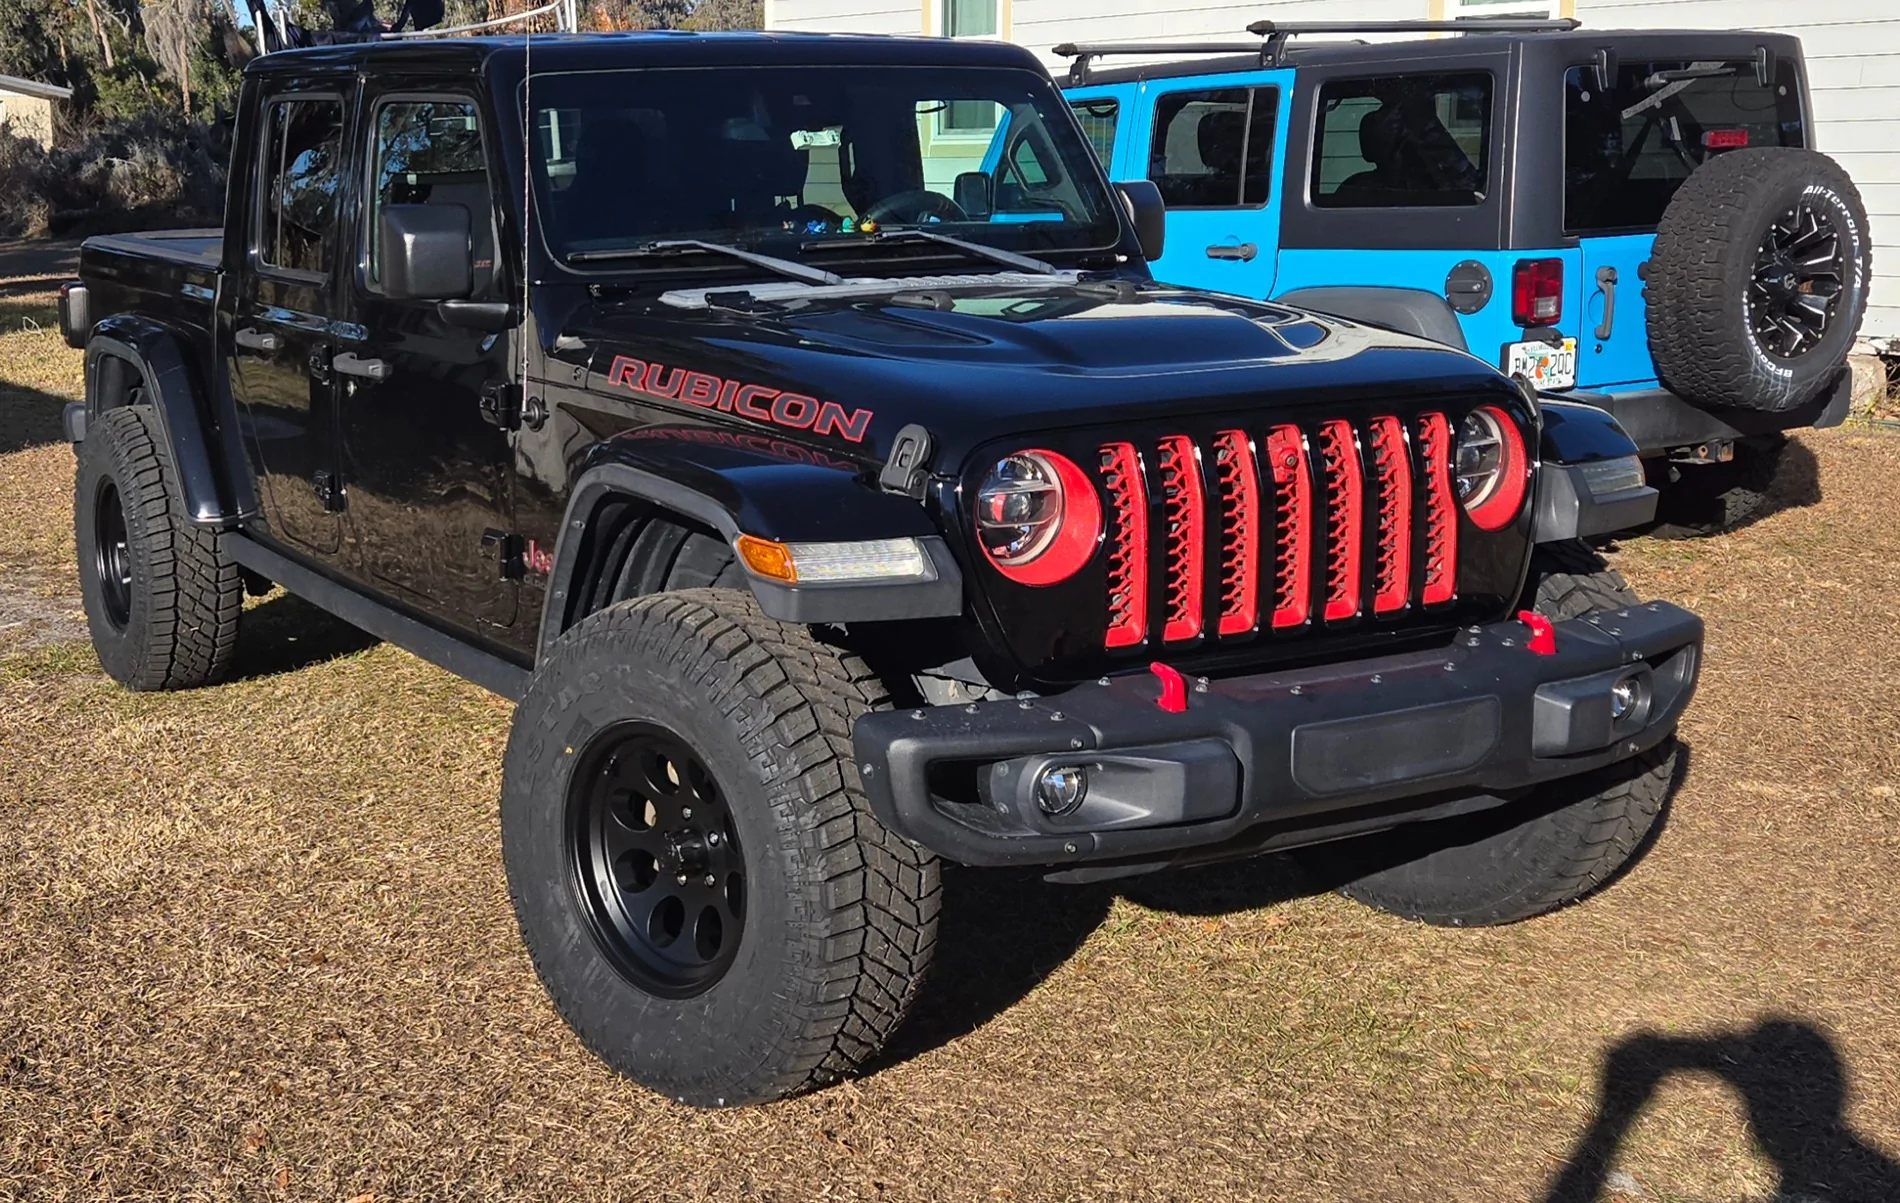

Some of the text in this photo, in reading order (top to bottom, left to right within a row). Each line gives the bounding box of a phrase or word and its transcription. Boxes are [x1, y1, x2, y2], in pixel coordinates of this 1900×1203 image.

[1802, 185, 1863, 289] All-Terrain T/A
[1742, 290, 1793, 378] BFGoodrich
[608, 355, 873, 443] RUBICON
[522, 539, 554, 574] Jee
